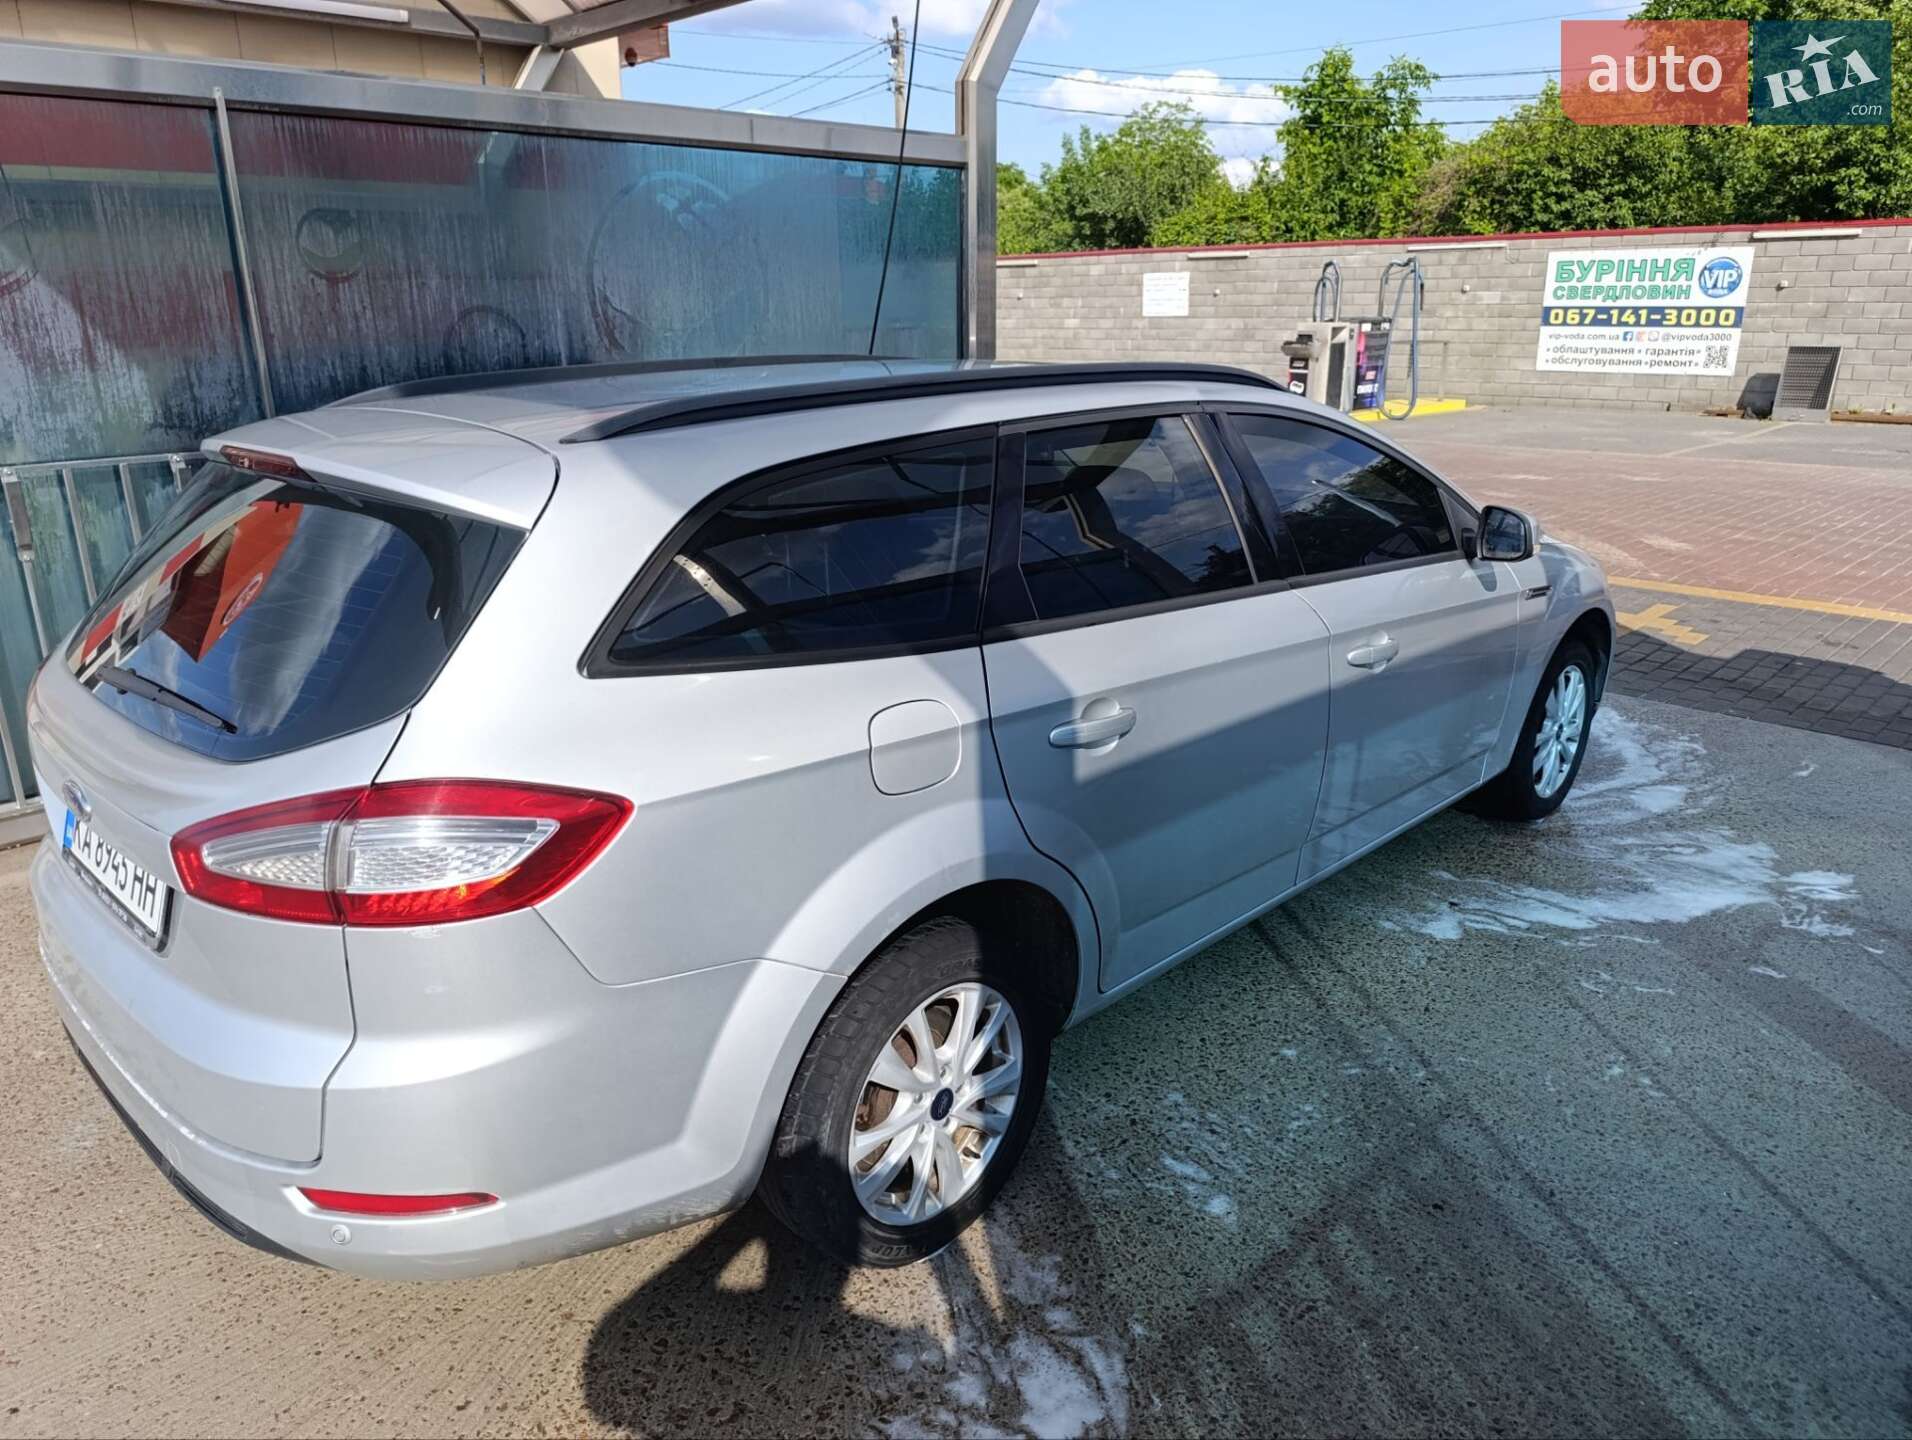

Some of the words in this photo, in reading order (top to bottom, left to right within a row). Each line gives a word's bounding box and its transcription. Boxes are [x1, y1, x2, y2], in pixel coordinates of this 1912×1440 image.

[1554, 257, 1697, 283] БУРІННЯ
[1703, 269, 1738, 289] VIP
[1552, 284, 1692, 302] СВЕРДЛОВИН
[1549, 308, 1737, 326] 067-141-3000
[1552, 344, 1635, 356] облаштування
[1645, 346, 1696, 358] гарантія
[1551, 355, 1642, 367] обслуговування
[1649, 359, 1694, 369] ремонт
